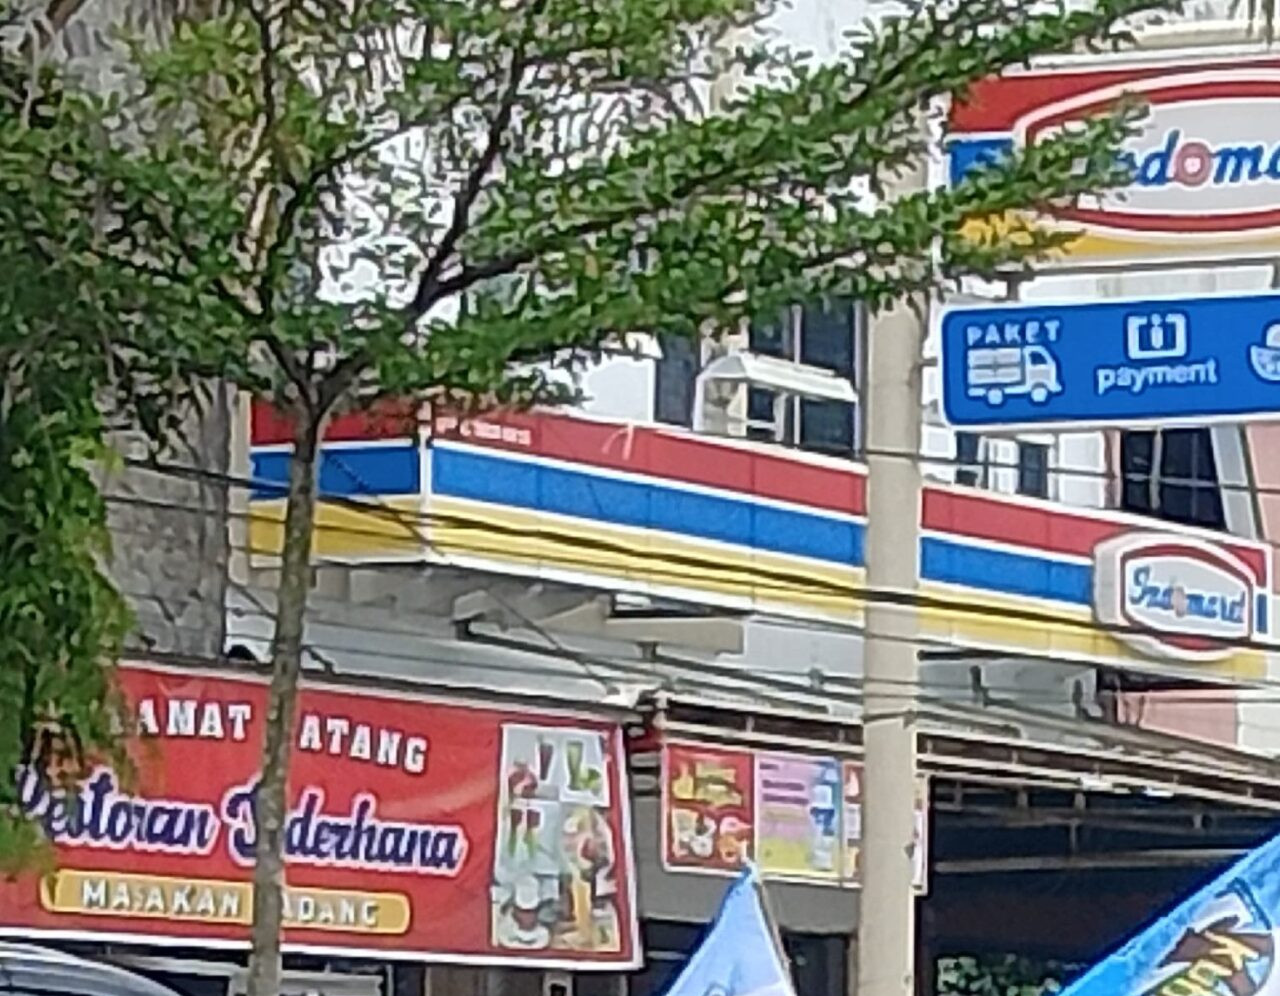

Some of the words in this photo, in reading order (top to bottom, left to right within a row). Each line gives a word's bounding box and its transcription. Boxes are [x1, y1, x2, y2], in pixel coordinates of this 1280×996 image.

[967, 320, 1060, 346] PAKET
[1096, 358, 1218, 395] payment
[300, 714, 428, 774] ATANG
